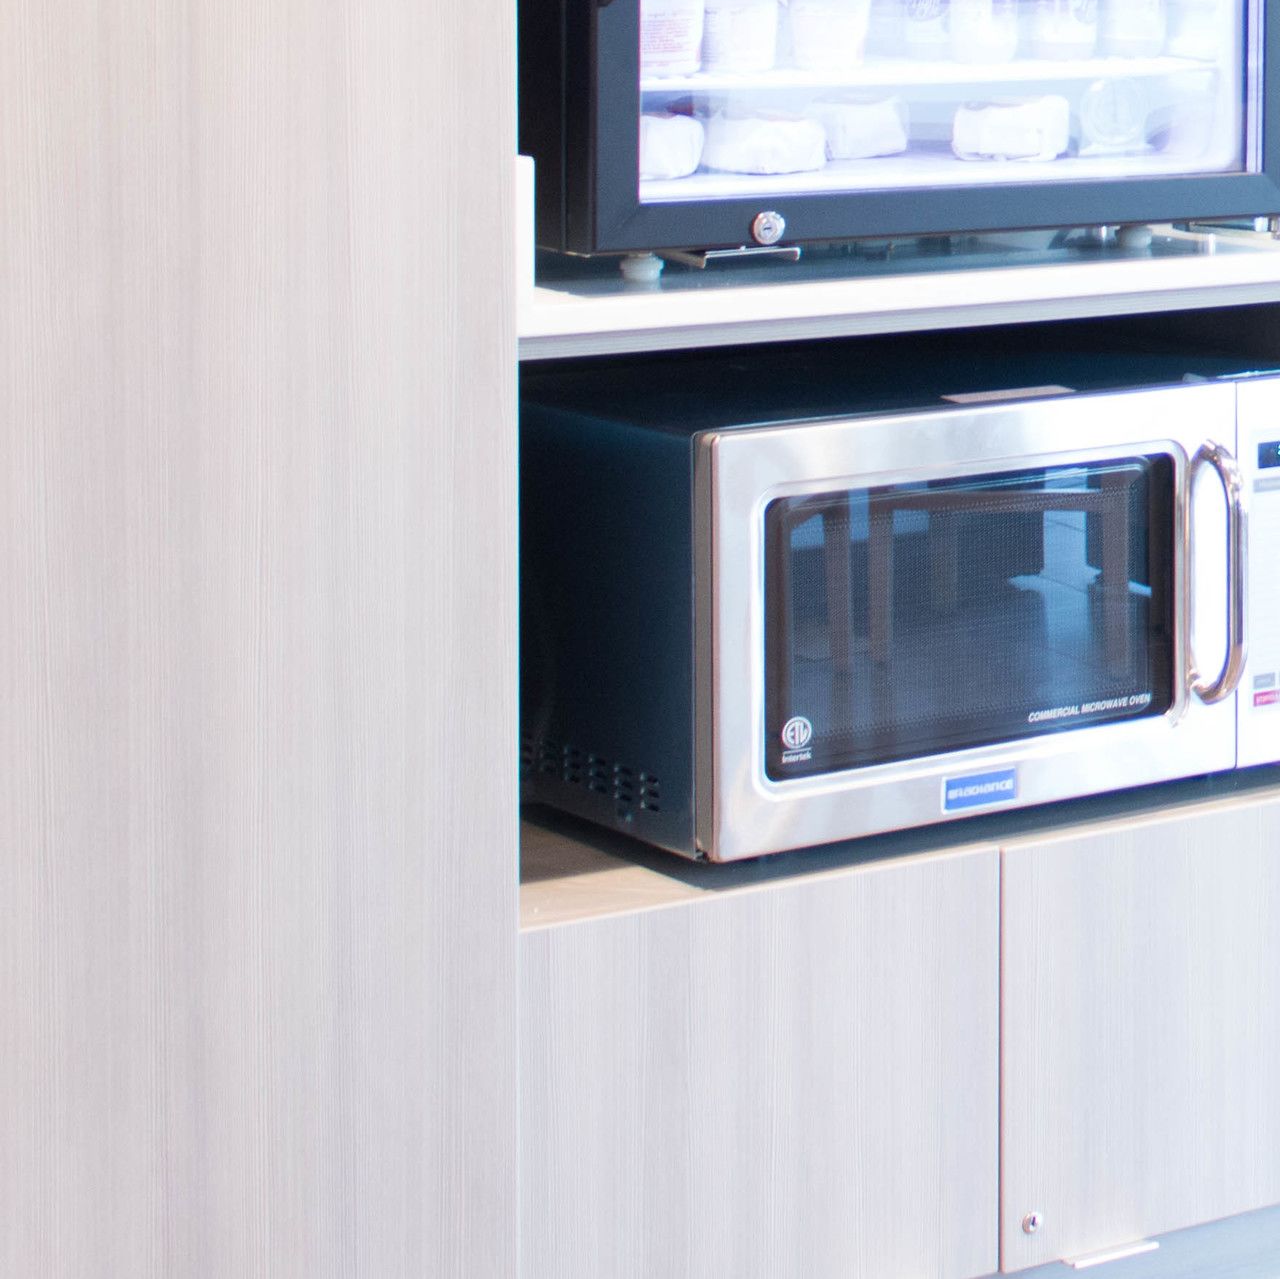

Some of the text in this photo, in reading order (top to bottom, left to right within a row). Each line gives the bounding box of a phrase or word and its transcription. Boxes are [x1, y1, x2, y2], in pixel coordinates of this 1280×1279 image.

[1028, 693, 1151, 723] COMMERCIAL MICROWAVE OVEN
[781, 750, 812, 764] Intertek
